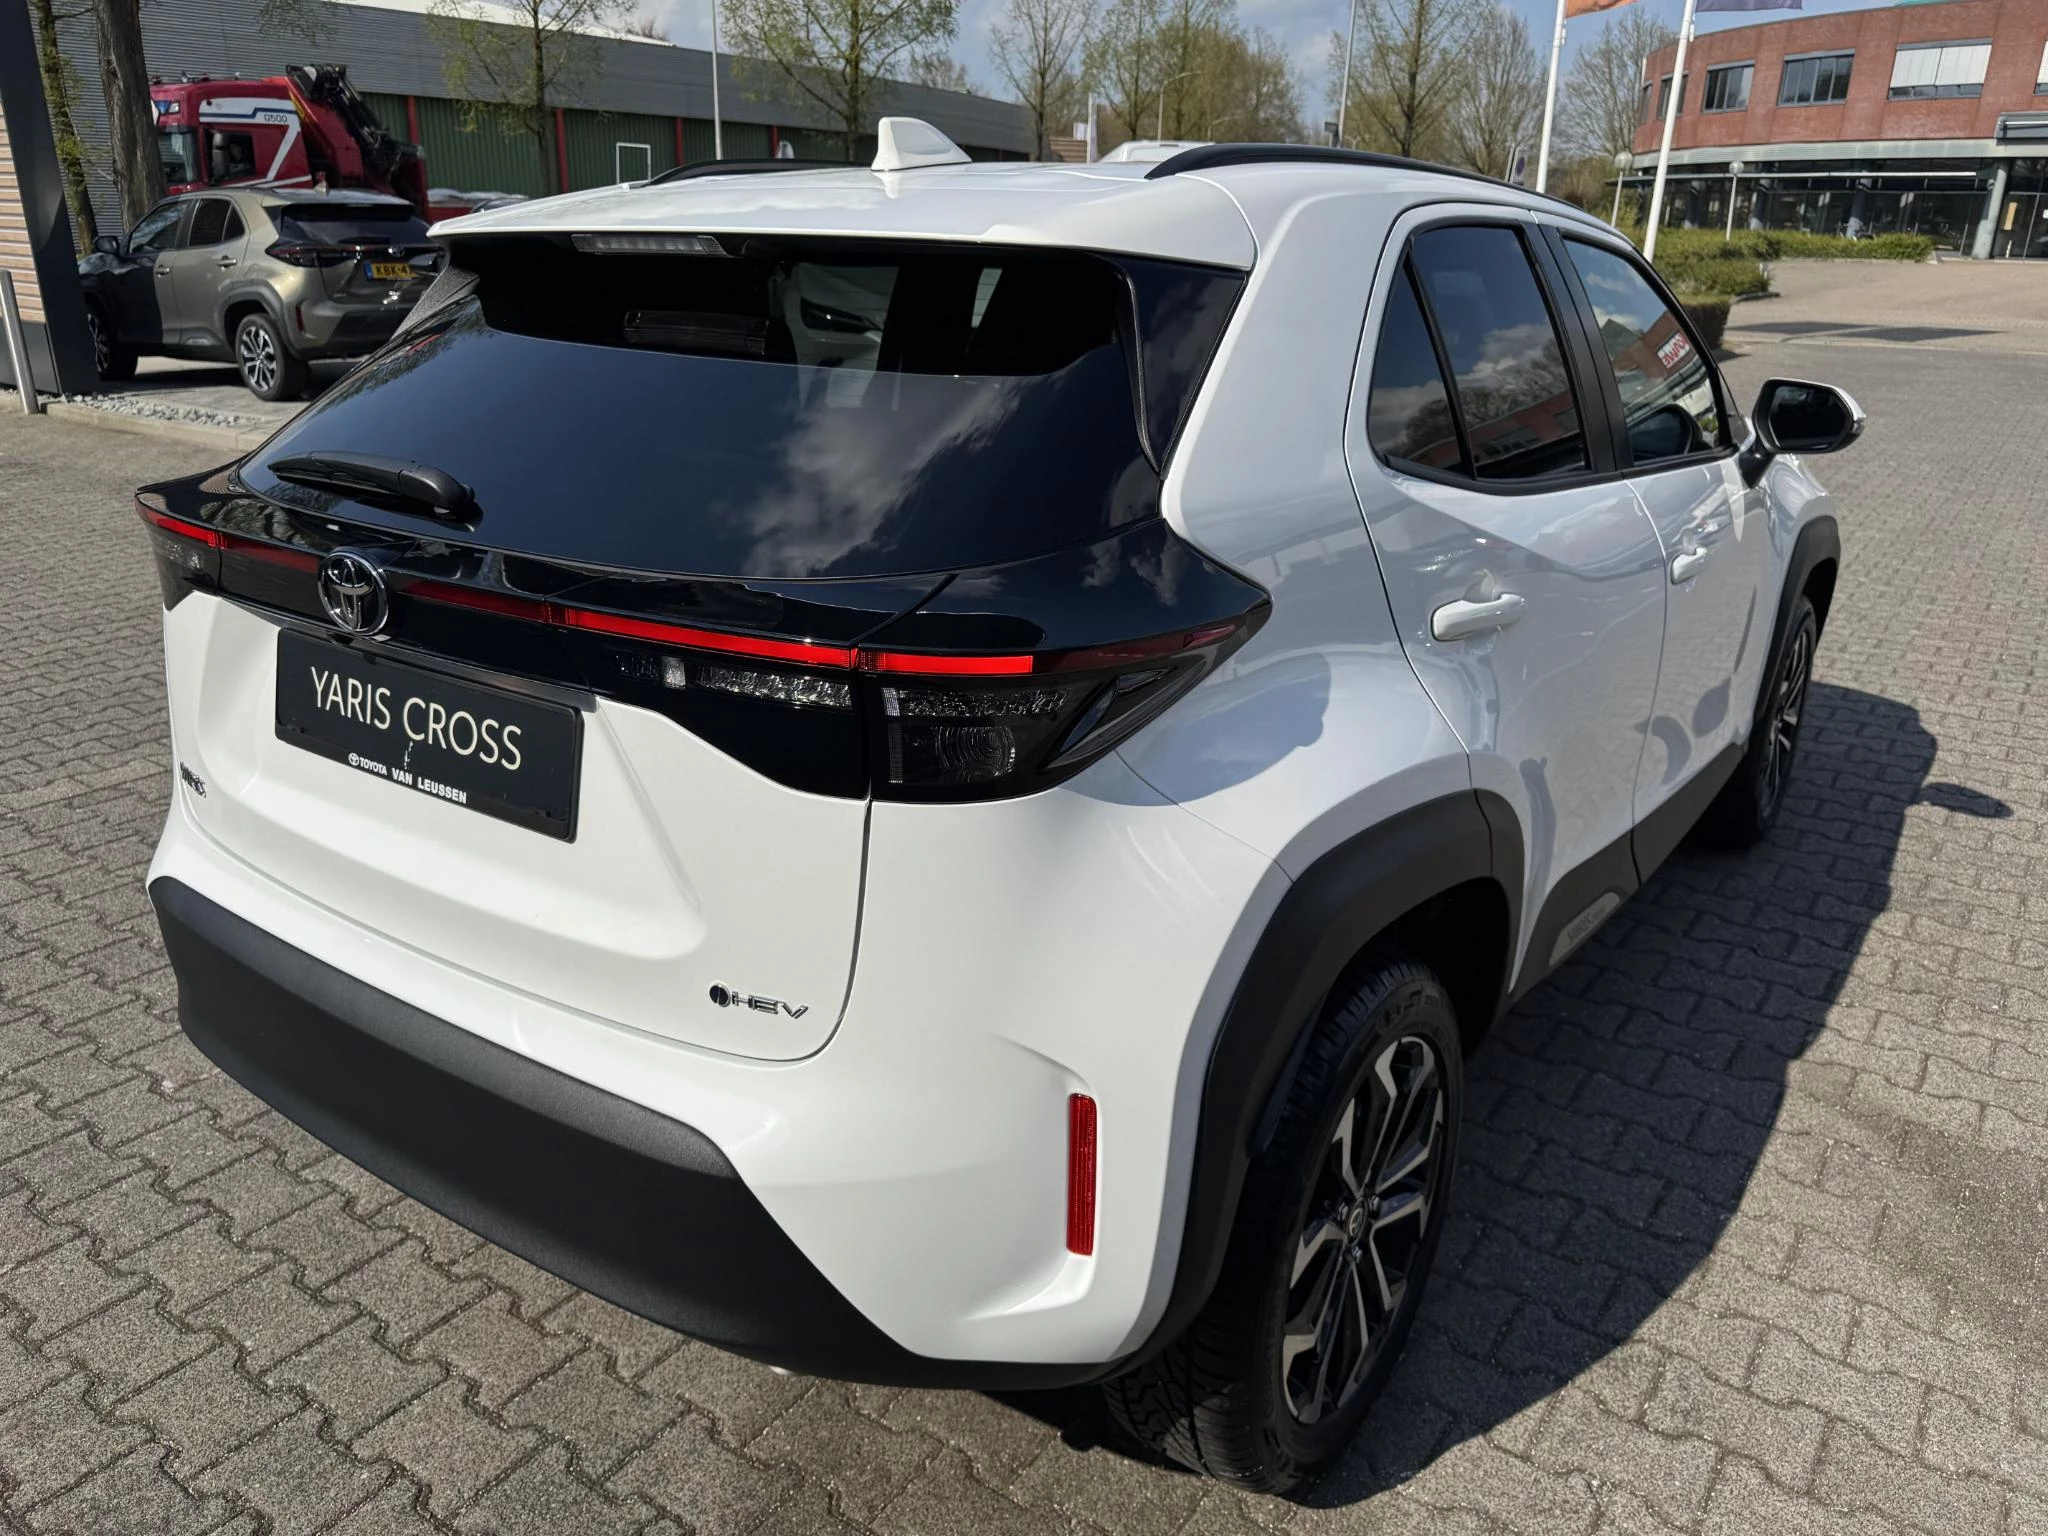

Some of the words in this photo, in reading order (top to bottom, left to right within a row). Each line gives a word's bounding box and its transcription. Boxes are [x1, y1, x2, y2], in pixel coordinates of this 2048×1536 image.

[311, 666, 391, 730] YARIS
[403, 697, 522, 770] CROSS
[359, 756, 388, 776] TOYOTA
[391, 767, 413, 786] VAN
[417, 776, 467, 804] LEUSSEN
[731, 990, 809, 1019] HEV
